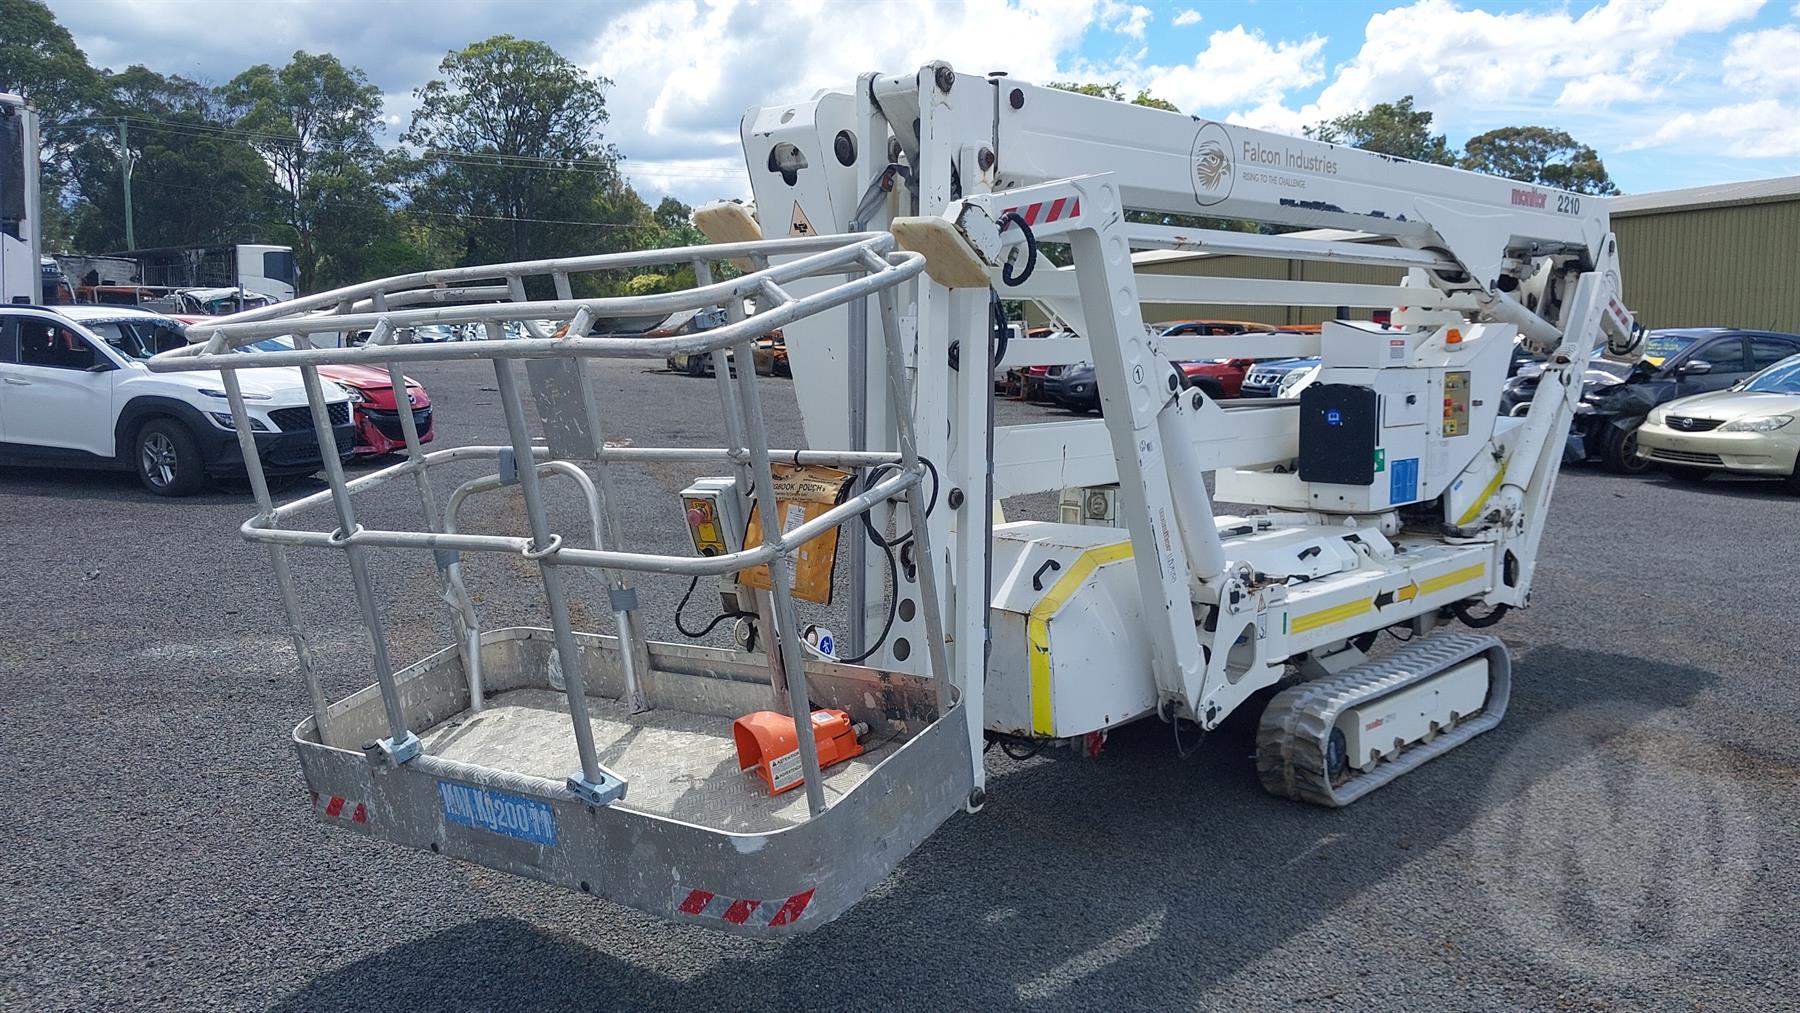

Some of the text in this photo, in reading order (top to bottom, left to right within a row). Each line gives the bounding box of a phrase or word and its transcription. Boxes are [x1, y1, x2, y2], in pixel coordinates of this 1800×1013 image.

[1243, 141, 1338, 175] Falcon Industries
[1278, 176, 1307, 189] CHALLENGE
[1557, 194, 1580, 215] 2210
